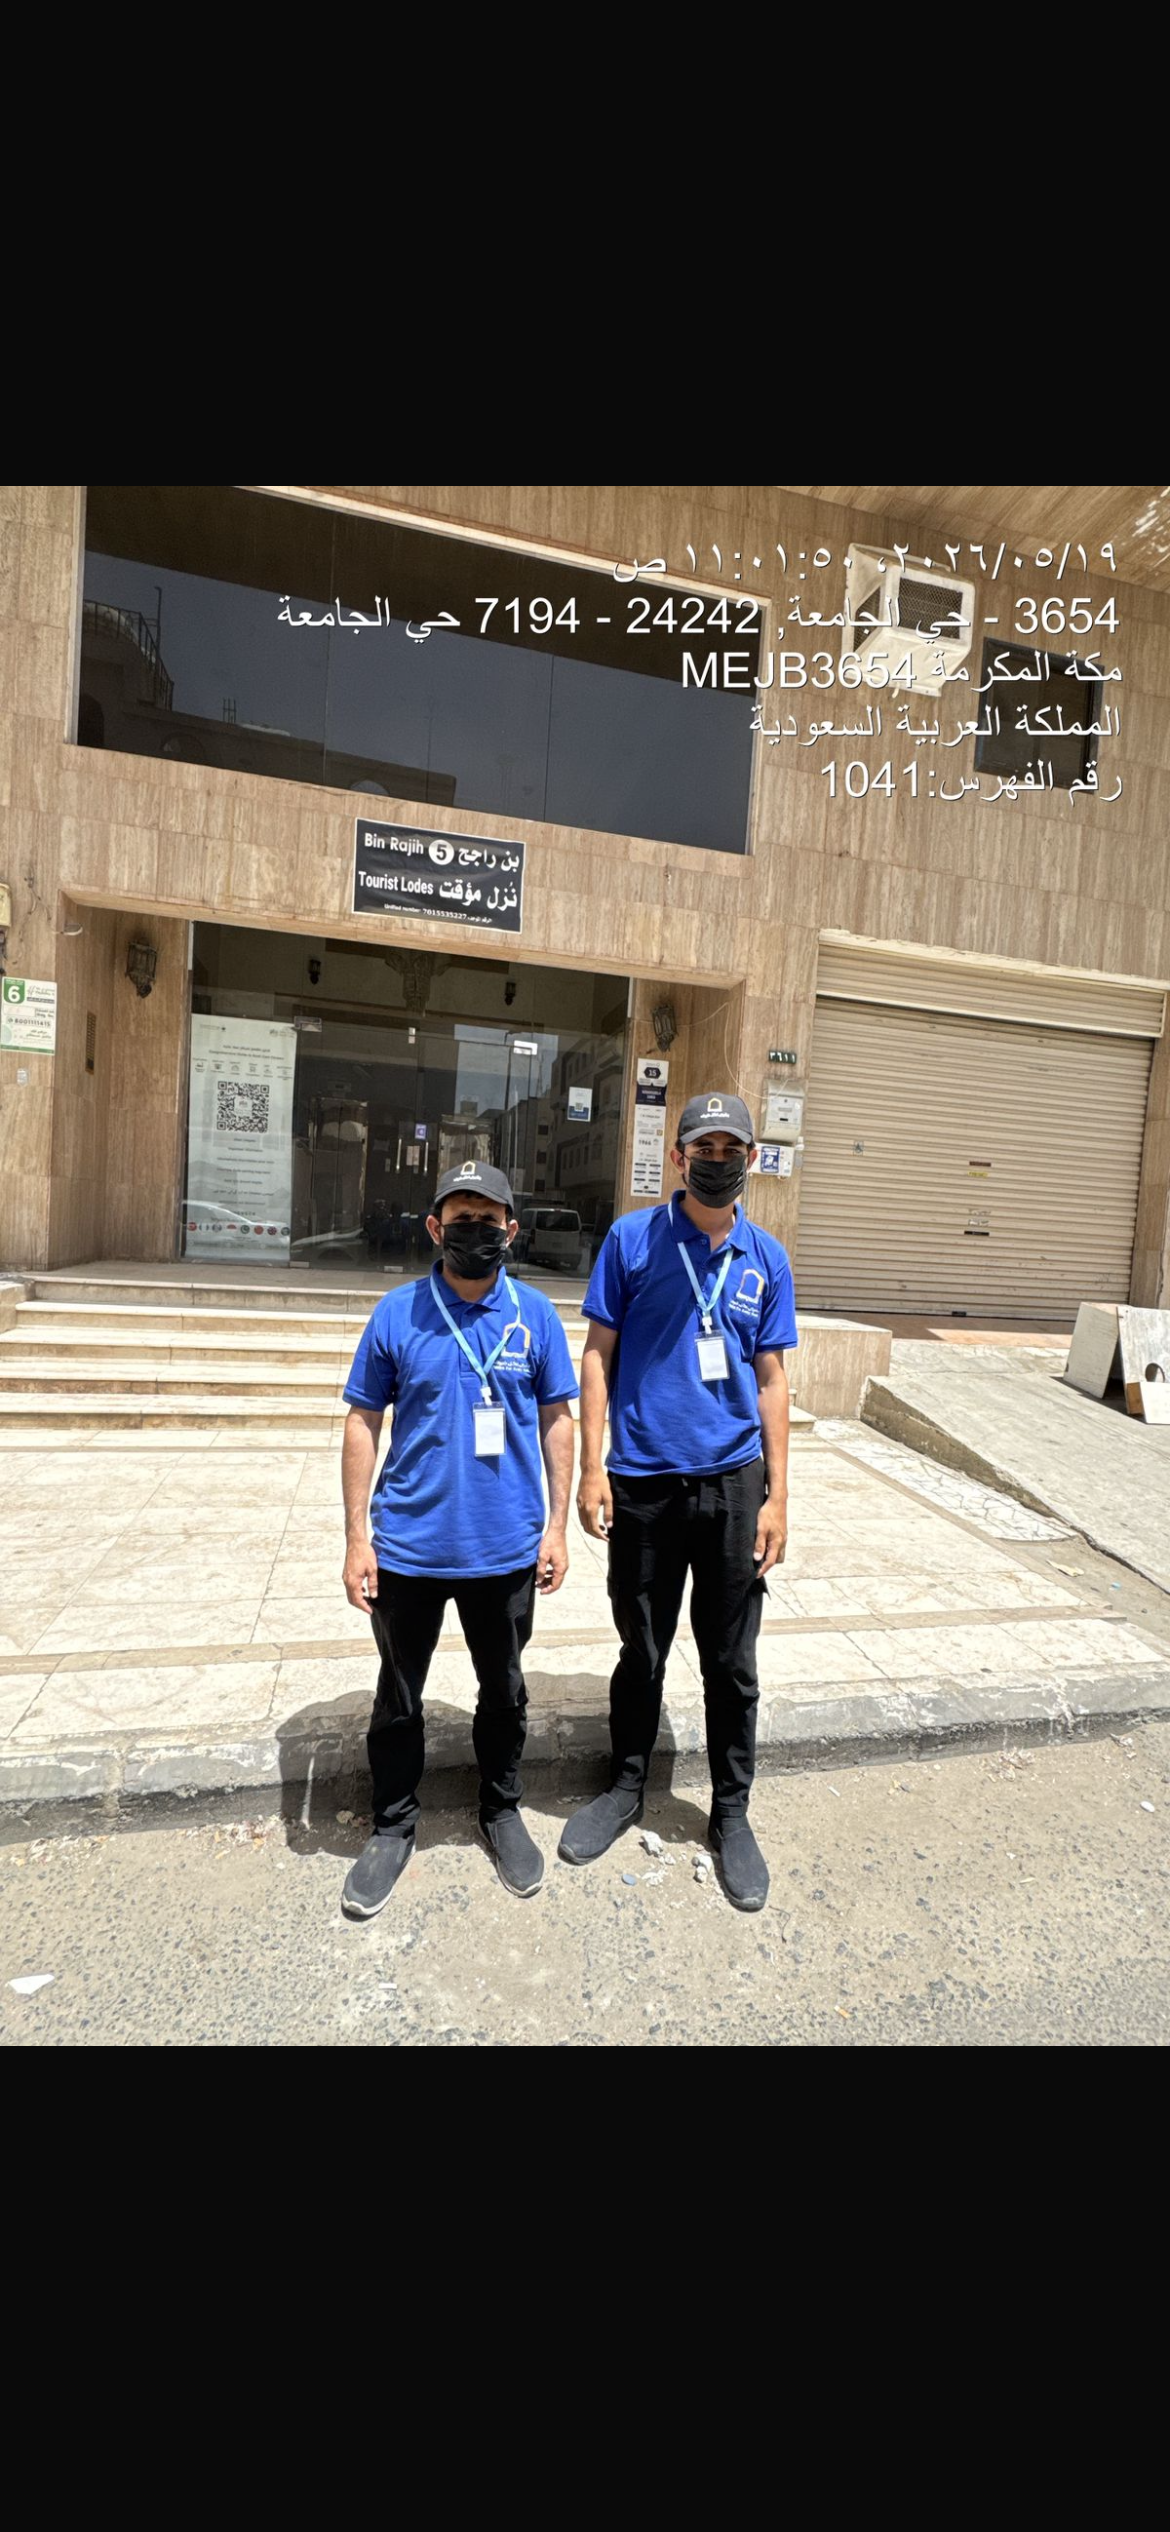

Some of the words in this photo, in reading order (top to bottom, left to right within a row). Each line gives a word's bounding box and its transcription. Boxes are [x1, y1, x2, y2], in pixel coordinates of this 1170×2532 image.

[364, 832, 386, 849] Bin
[389, 836, 424, 857] Rajih
[458, 847, 497, 868] راجح
[500, 850, 520, 873] بن
[358, 871, 399, 891] Tourist
[400, 876, 434, 895] Lodes
[439, 878, 482, 906] مؤقت
[8, 985, 21, 1003] 6
